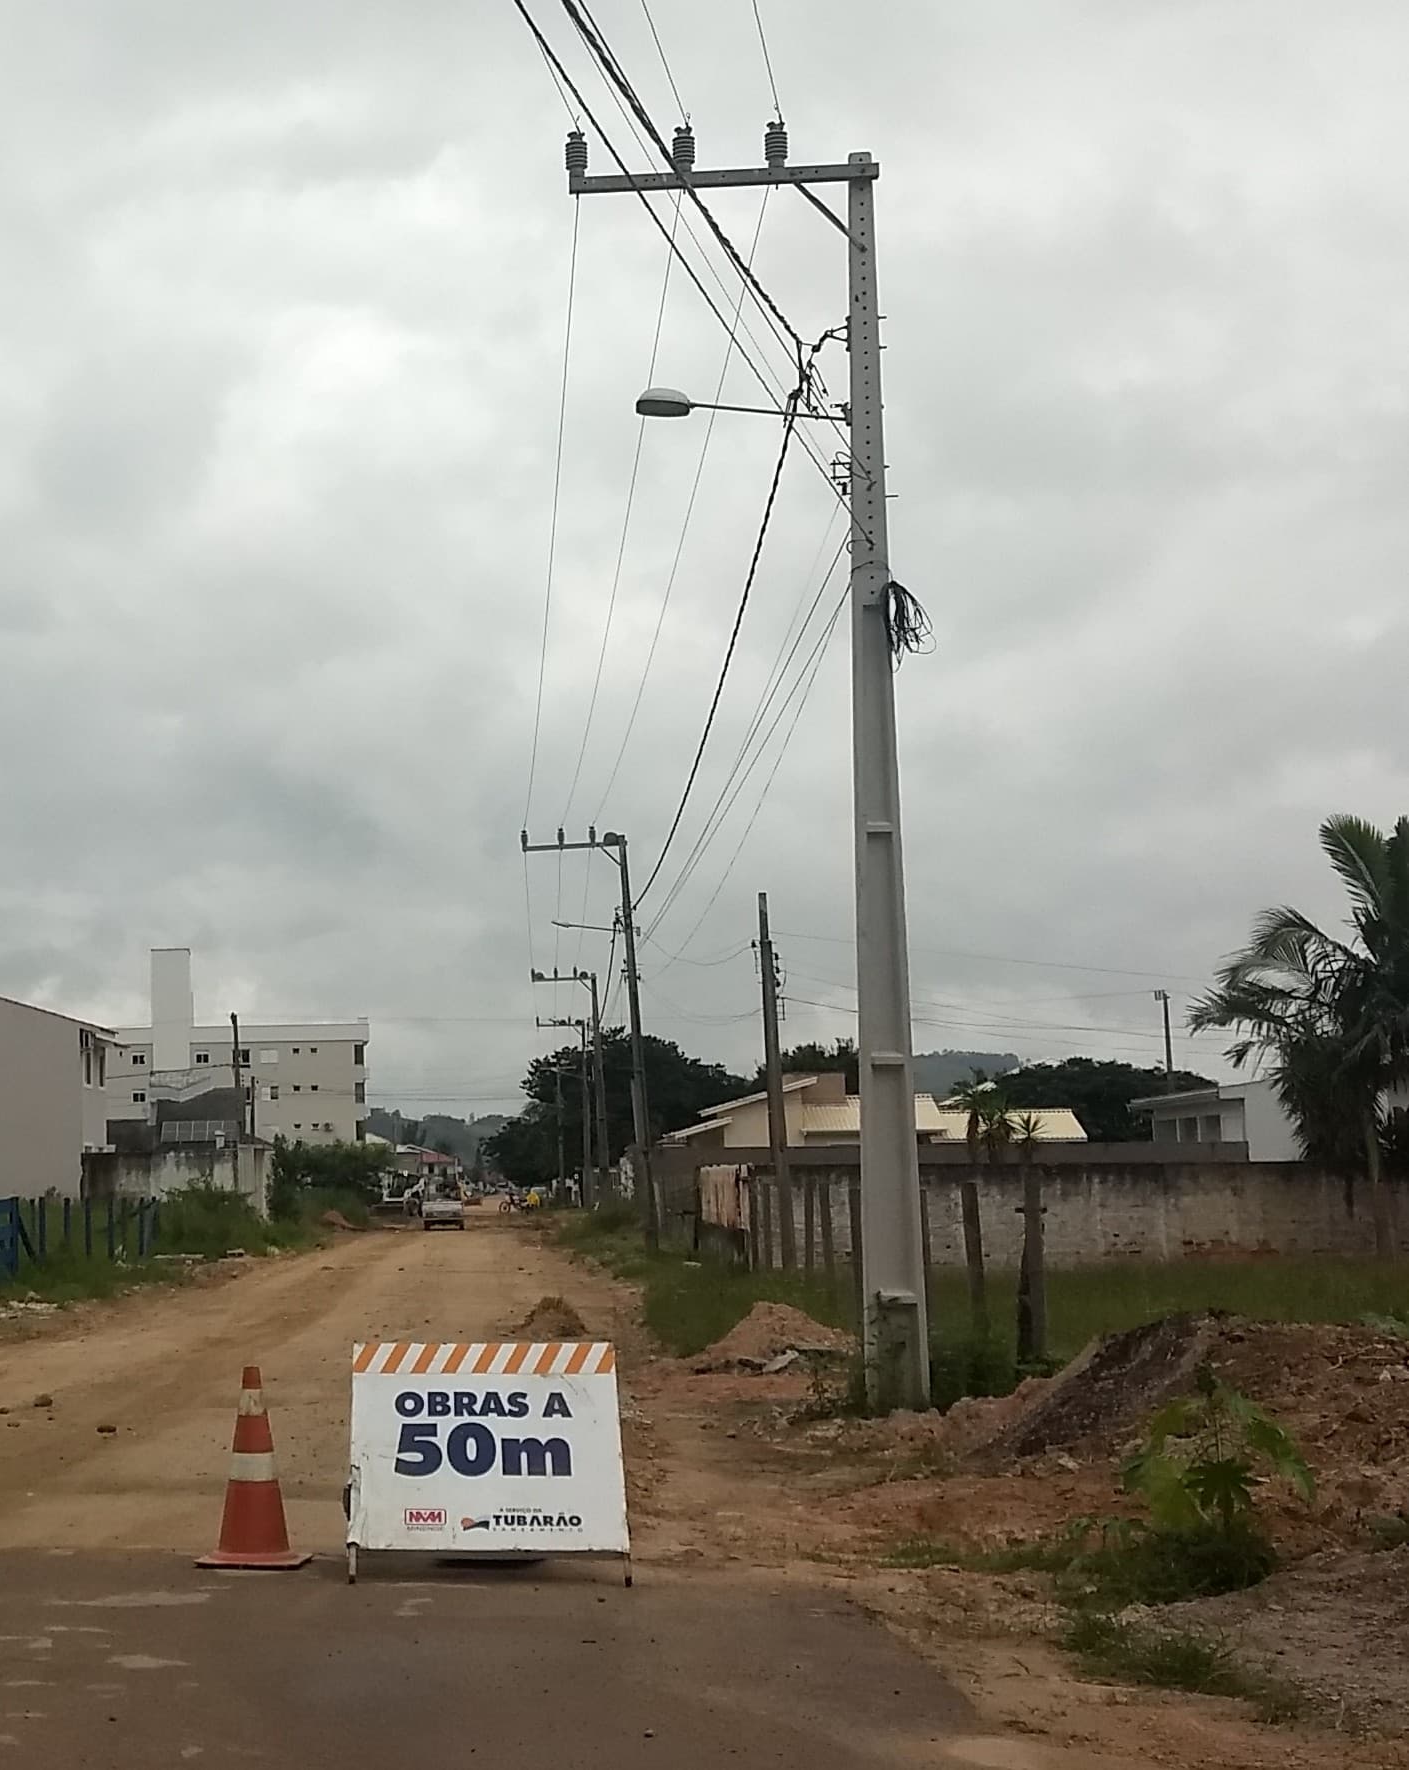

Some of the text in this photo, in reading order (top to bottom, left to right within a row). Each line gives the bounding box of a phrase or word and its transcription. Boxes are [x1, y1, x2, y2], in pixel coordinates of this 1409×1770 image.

[394, 1391, 573, 1418] OBRAS A
[394, 1422, 573, 1477] 50m
[493, 1512, 583, 1527] TUBARÃO
